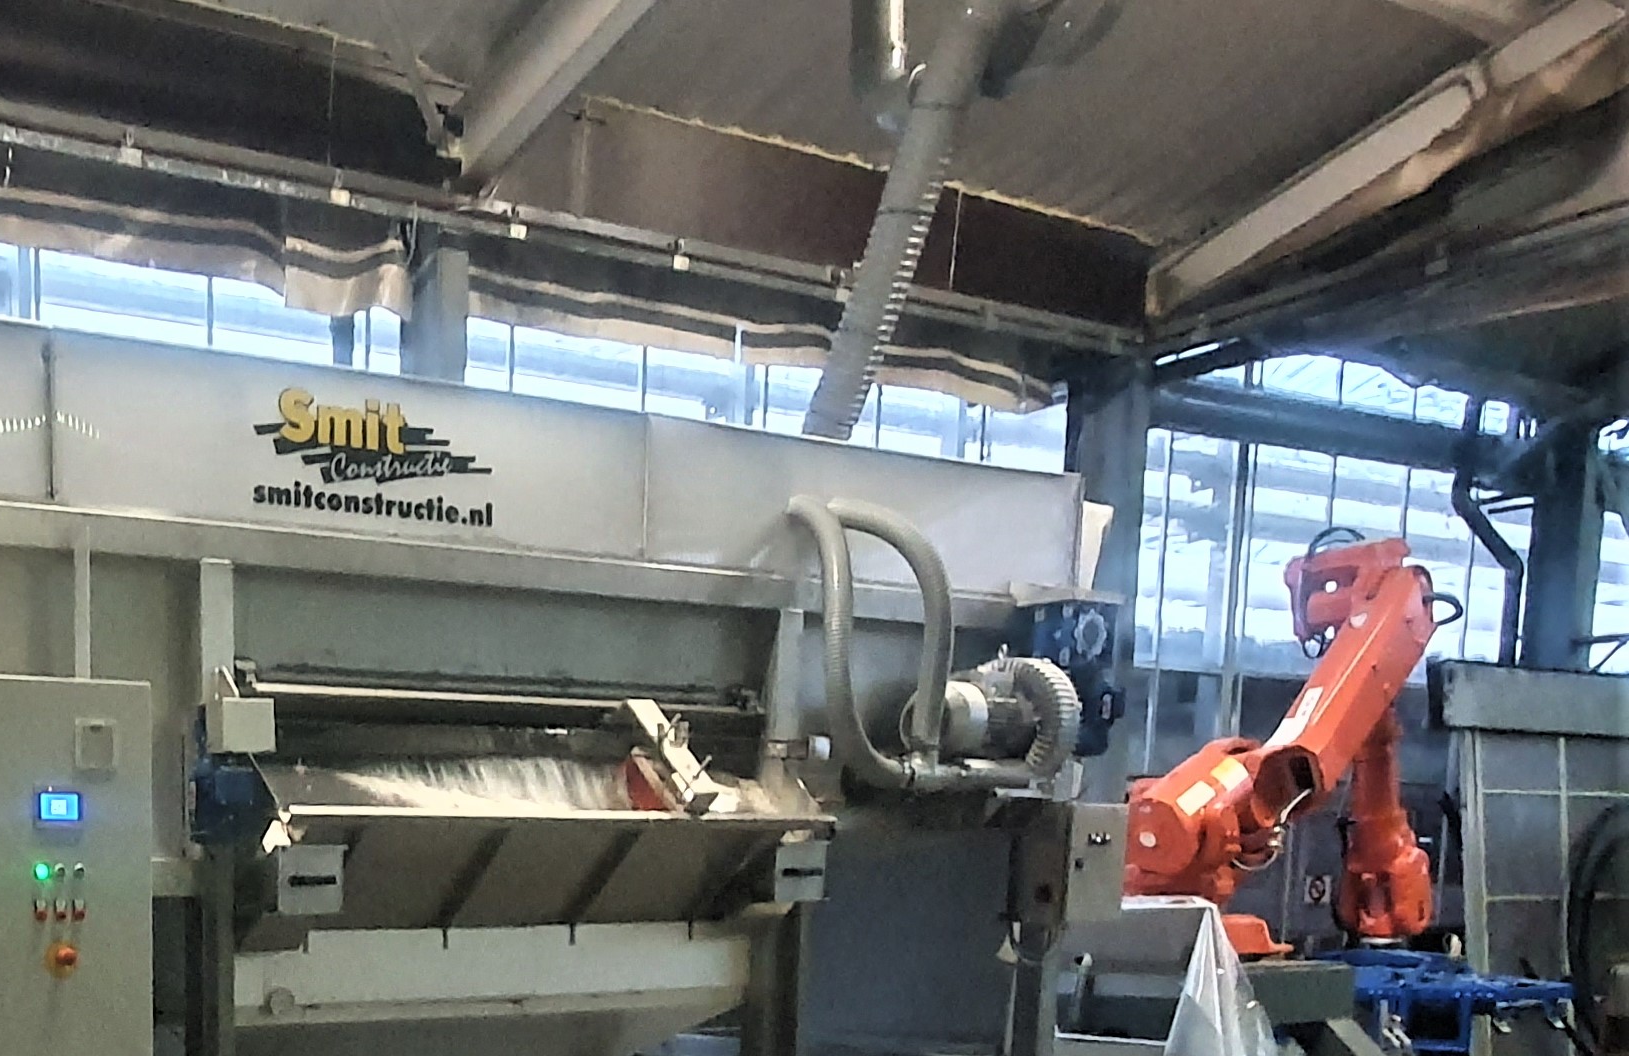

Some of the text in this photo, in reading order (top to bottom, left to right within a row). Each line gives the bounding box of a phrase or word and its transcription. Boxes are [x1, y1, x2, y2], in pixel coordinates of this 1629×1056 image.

[278, 387, 406, 455] Smit
[329, 451, 450, 482] Constructie
[252, 480, 493, 527] smitconstructie.nl
